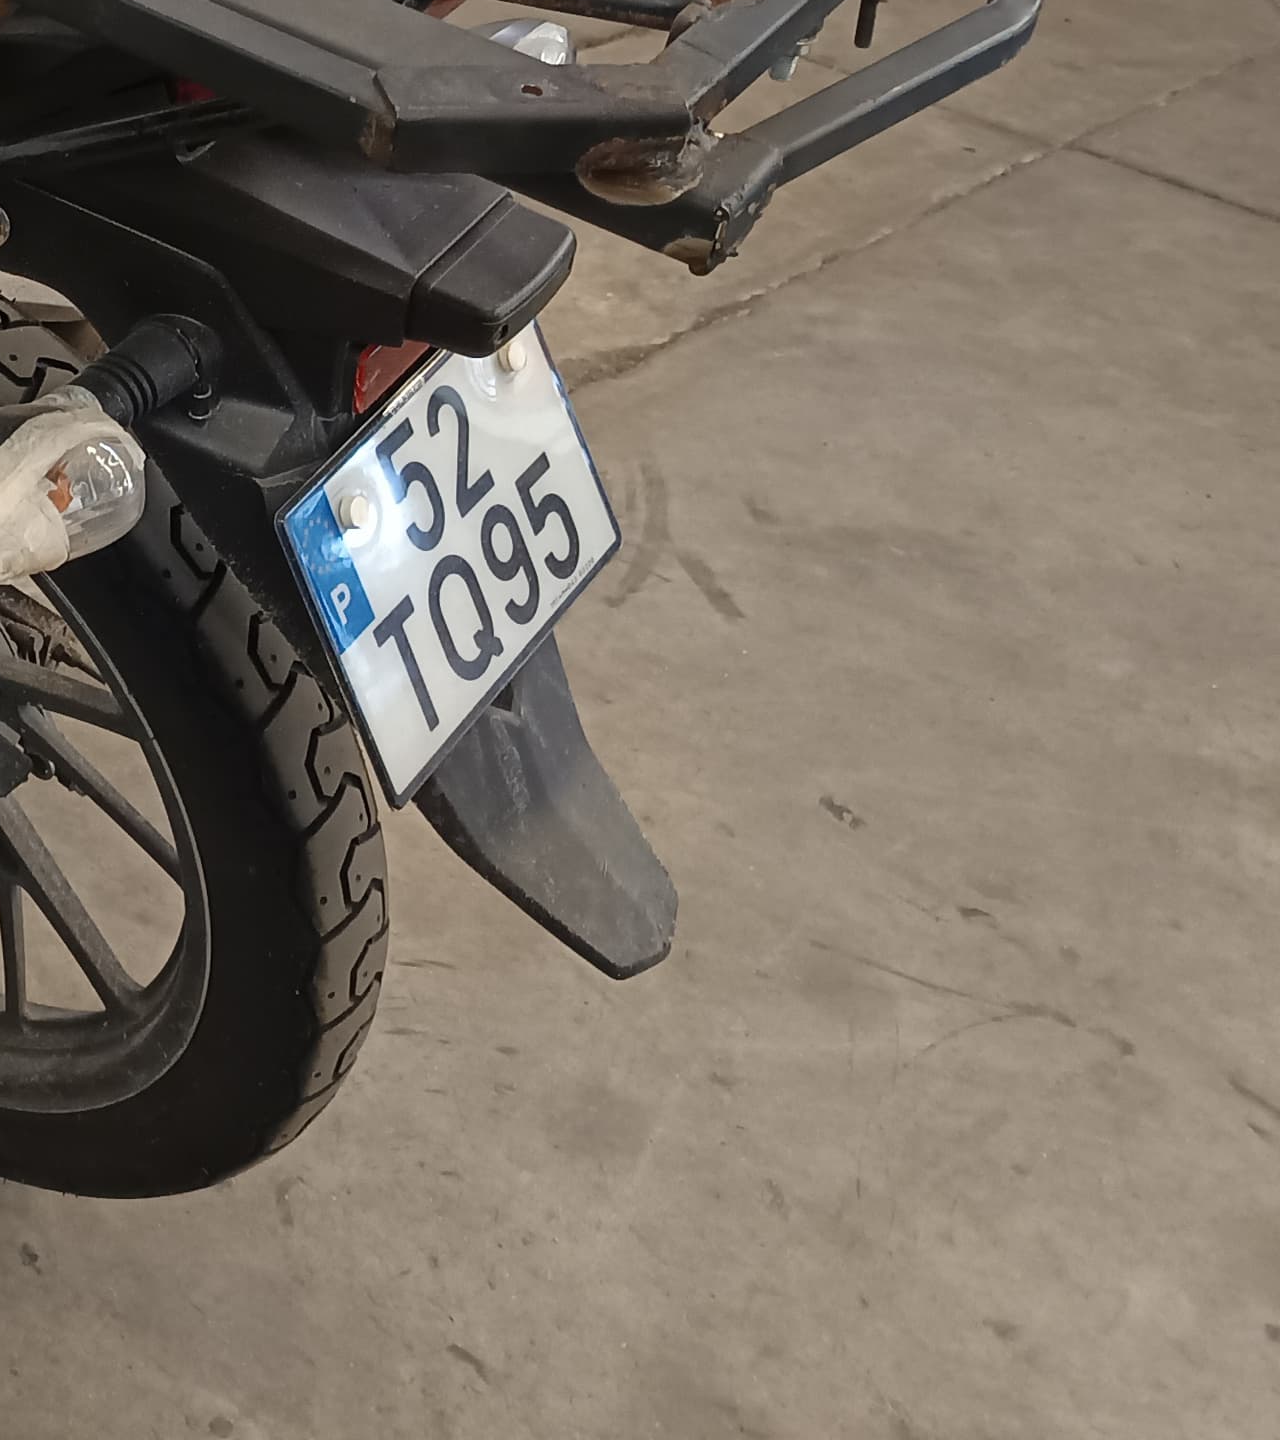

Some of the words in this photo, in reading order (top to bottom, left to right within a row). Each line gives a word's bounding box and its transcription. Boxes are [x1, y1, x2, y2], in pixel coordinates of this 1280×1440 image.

[375, 385, 495, 551] 52
[330, 582, 352, 626] P
[373, 452, 579, 732] TQ95
